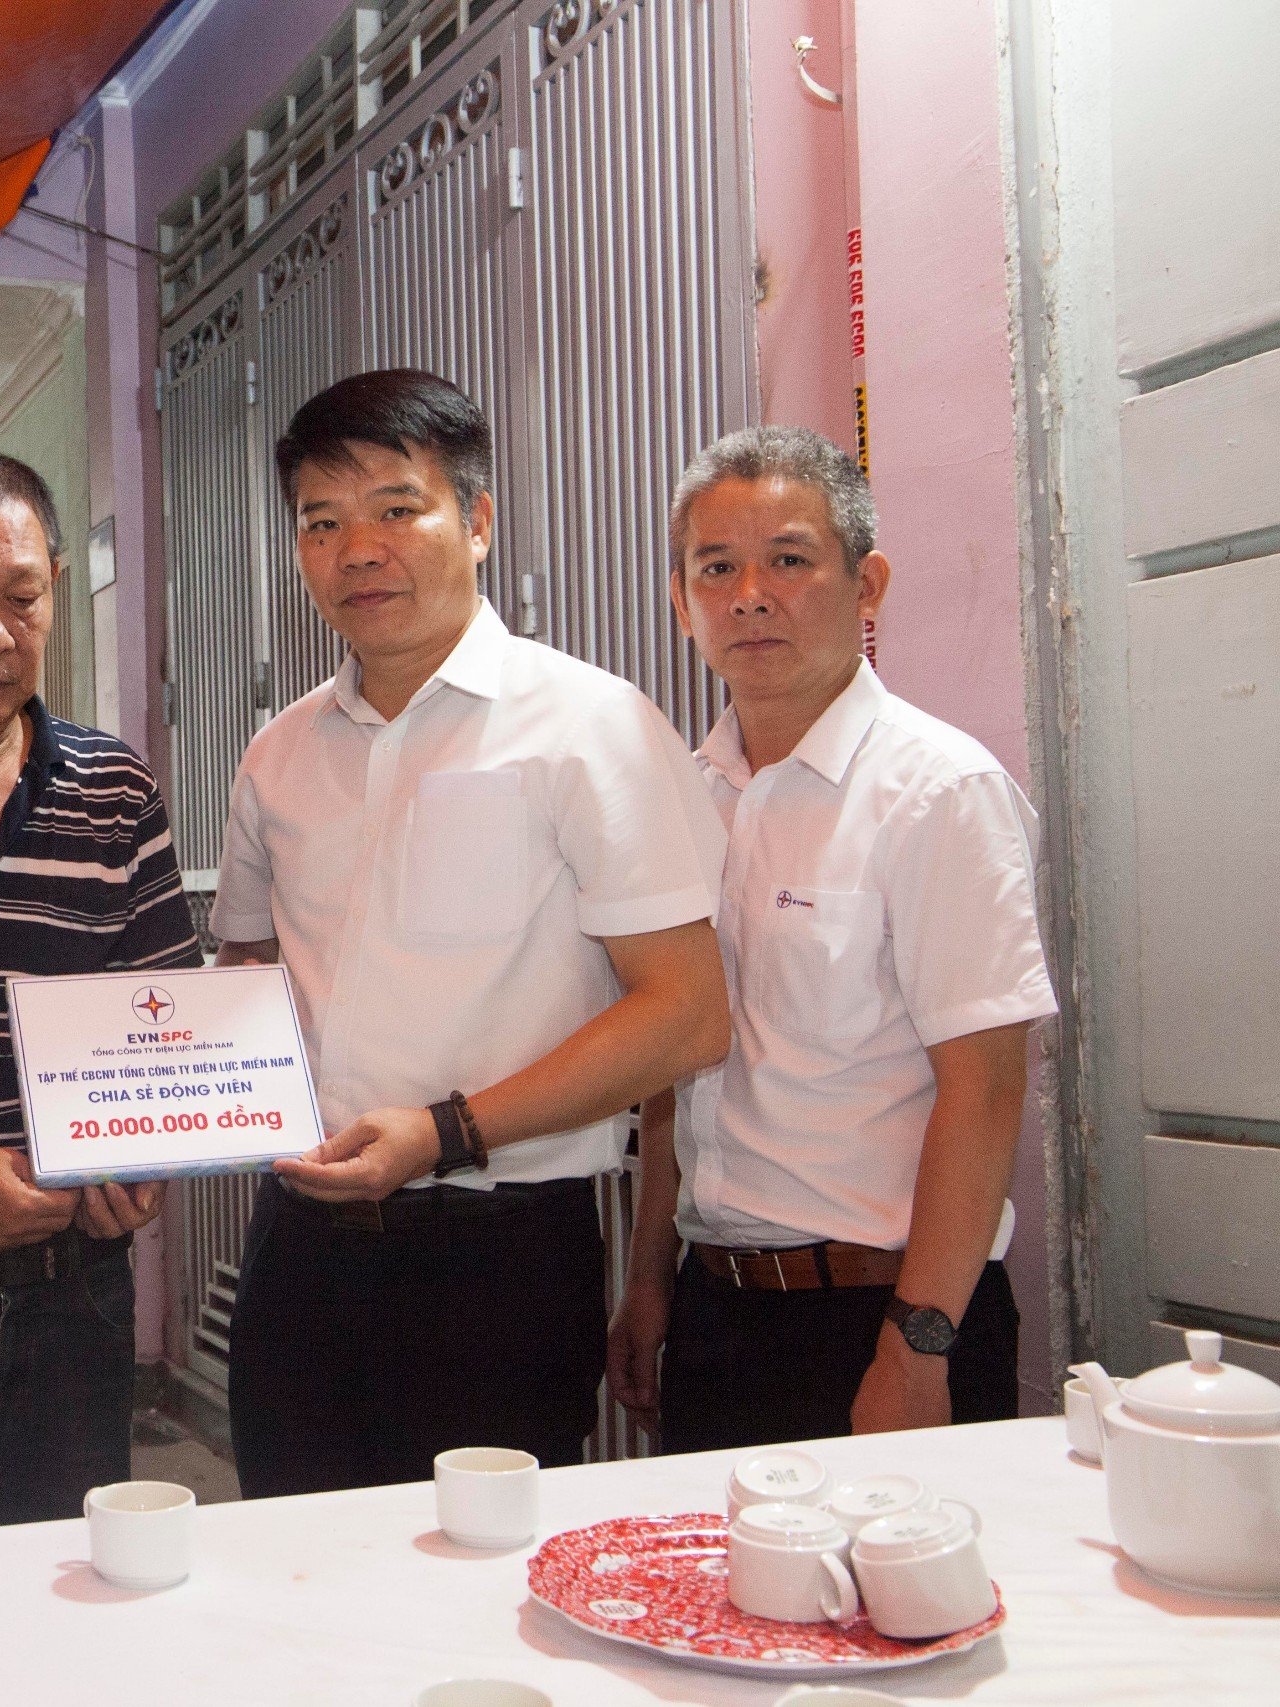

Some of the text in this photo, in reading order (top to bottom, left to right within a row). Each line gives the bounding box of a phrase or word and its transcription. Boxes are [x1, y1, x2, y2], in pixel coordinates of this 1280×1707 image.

[91, 1046, 115, 1057] TỔNG
[117, 1047, 142, 1056] CÔNG
[155, 1045, 174, 1055] ĐIỆN
[176, 1044, 192, 1054] LỰC
[215, 1041, 234, 1049] NAM
[126, 1030, 193, 1044] EVNSPC
[37, 1071, 57, 1086] TẬP
[60, 1067, 79, 1082] THỂ
[81, 1069, 116, 1081] CBCNV
[118, 1065, 145, 1079] TỔNG
[148, 1064, 176, 1077] CÔNG
[178, 1064, 190, 1075] TY
[192, 1061, 217, 1076] ĐIỆN
[219, 1060, 239, 1074] LỰC
[270, 1056, 294, 1068] NAM
[88, 1078, 253, 1103] CHIA SẺ ĐỘNG VIÊN
[69, 1104, 283, 1140] 20.000.000 đồng
